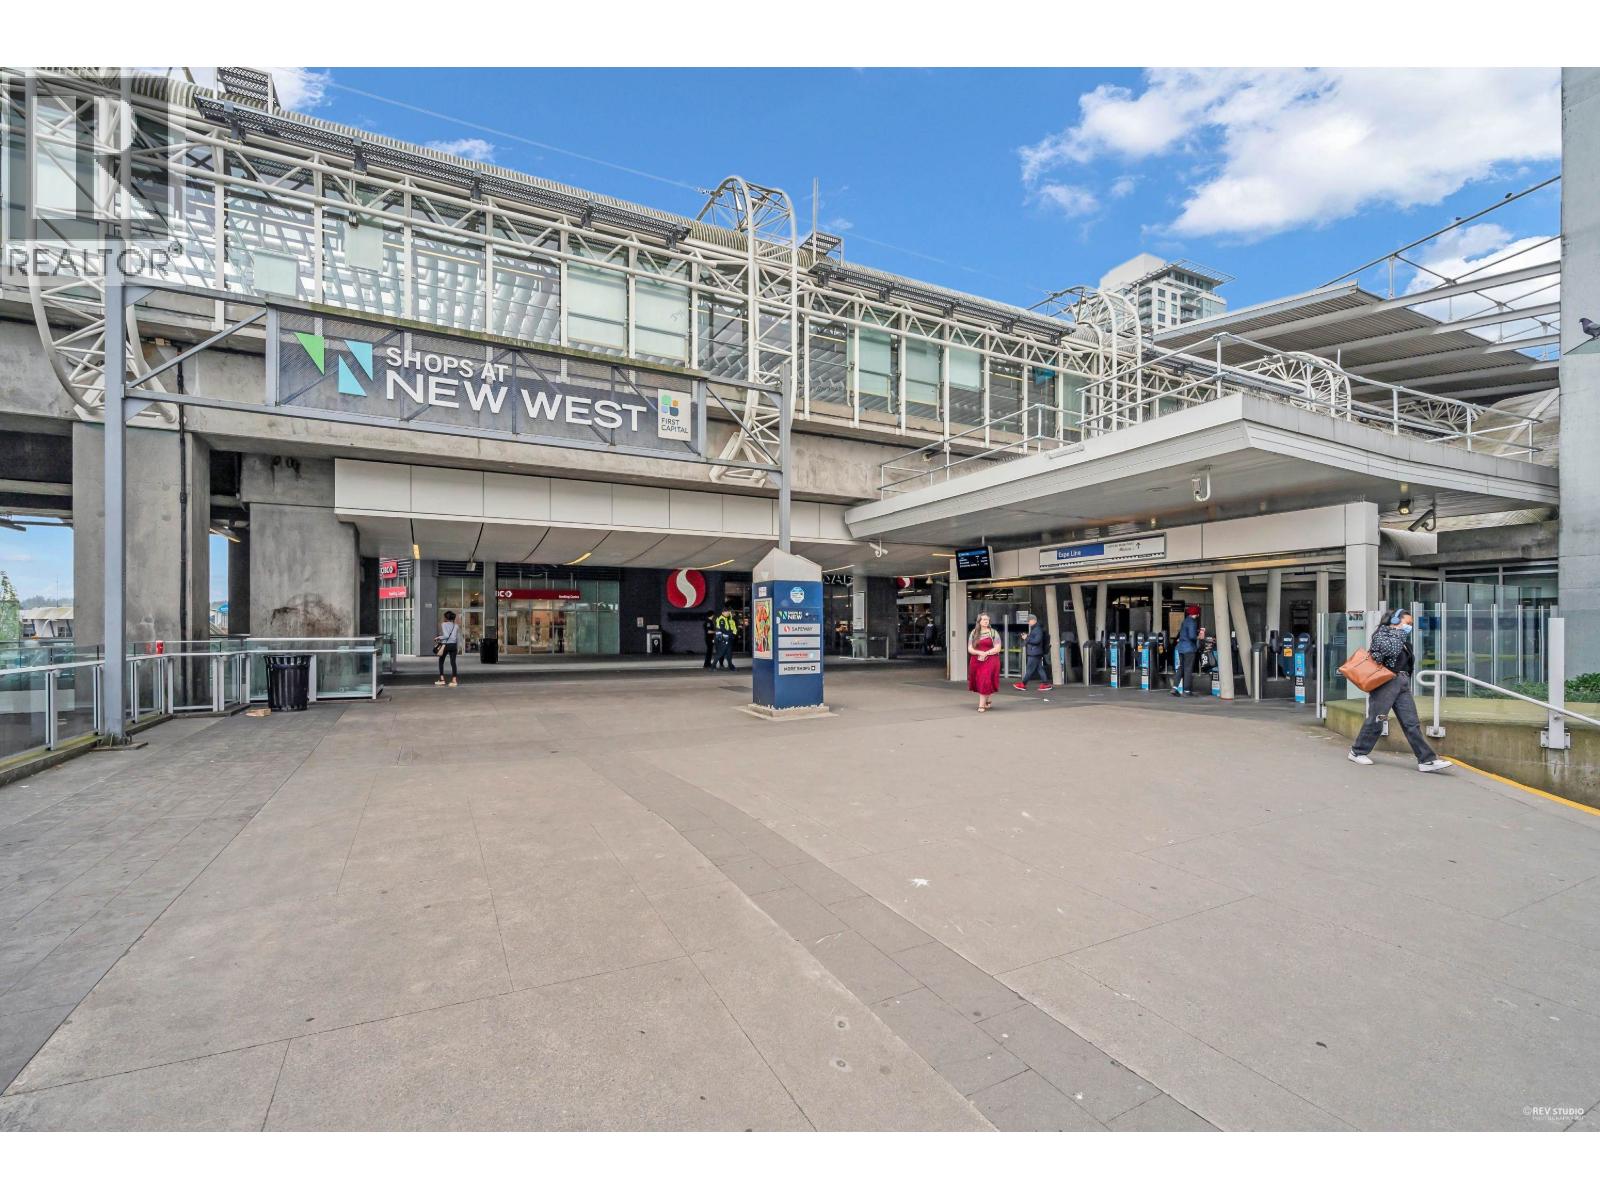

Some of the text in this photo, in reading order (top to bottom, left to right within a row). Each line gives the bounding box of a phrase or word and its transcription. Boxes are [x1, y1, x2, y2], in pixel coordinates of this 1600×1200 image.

[386, 347, 508, 382] SHOPS AT
[386, 370, 647, 432] NEW WEST
[661, 425, 688, 433] CAPITAL
